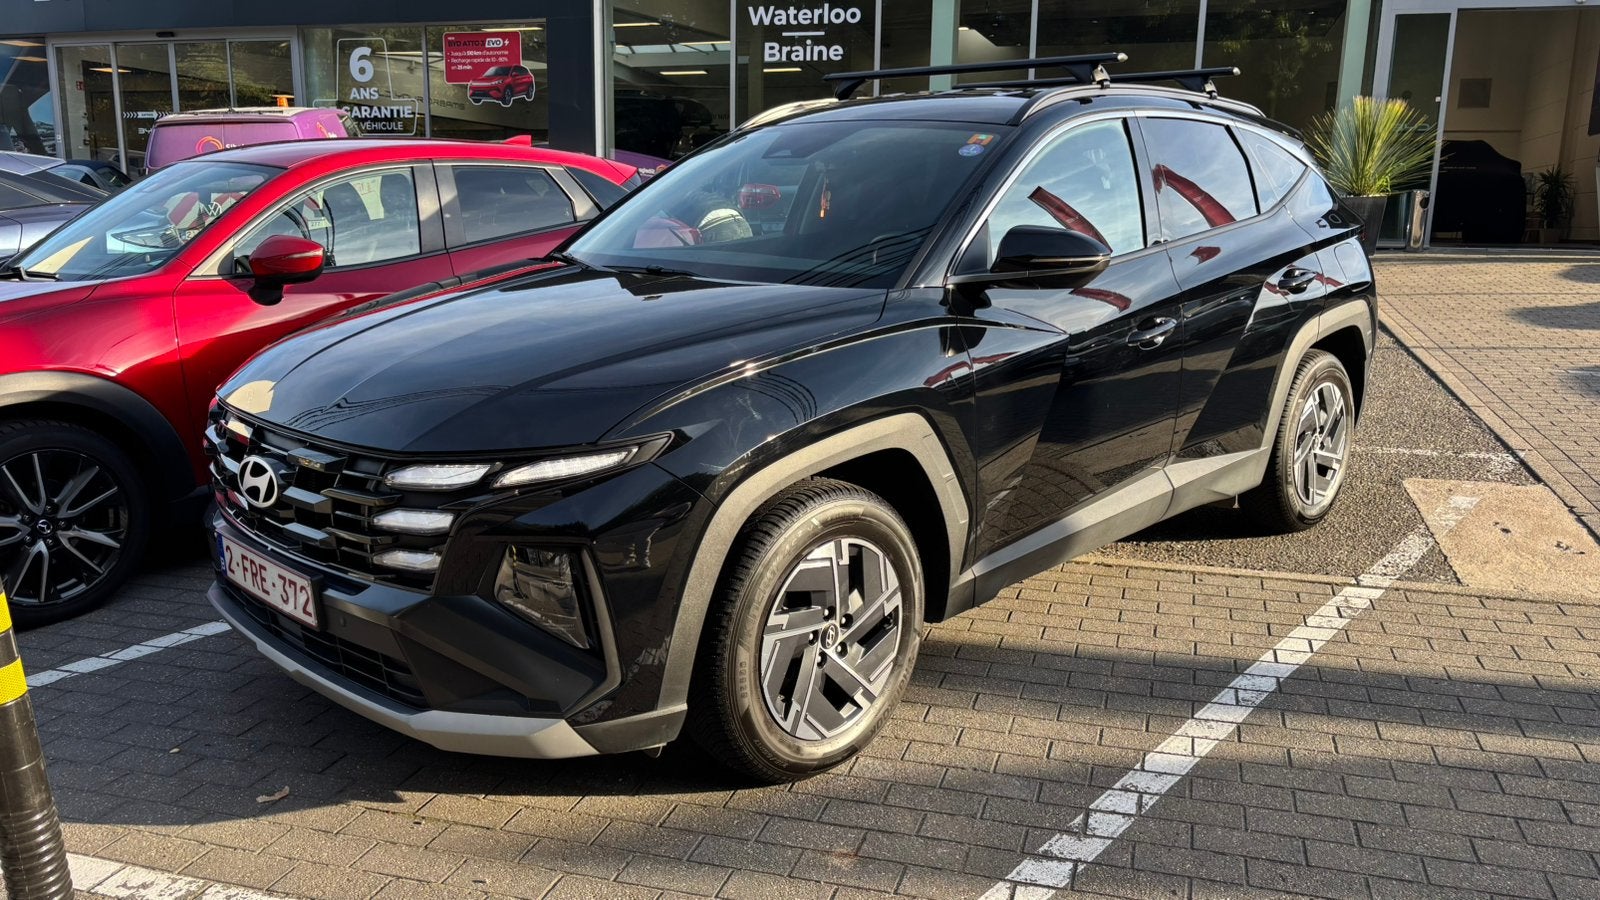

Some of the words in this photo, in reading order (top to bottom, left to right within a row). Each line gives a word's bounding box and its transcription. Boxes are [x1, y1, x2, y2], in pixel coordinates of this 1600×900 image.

[748, 3, 861, 26] Waterloo
[763, 39, 844, 62] Braine
[349, 46, 375, 83] 6
[350, 87, 379, 100] ANS
[360, 119, 404, 131] VÉHICULE
